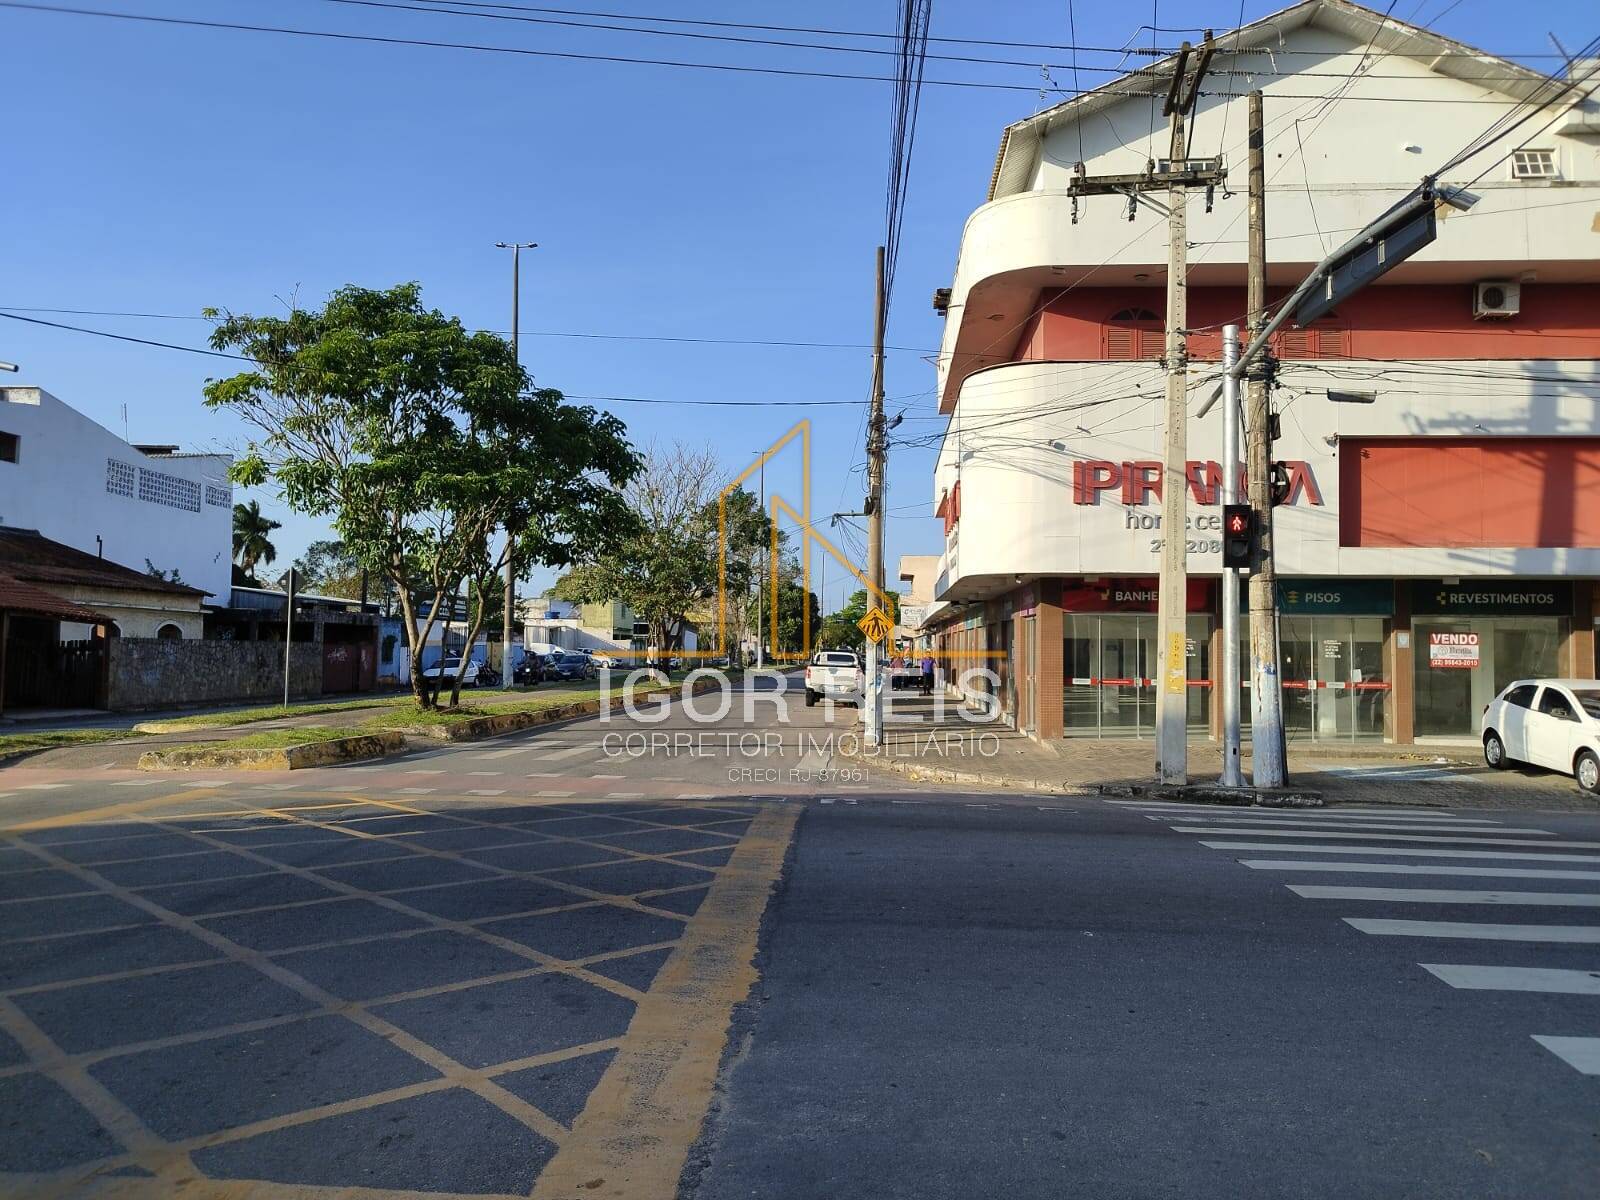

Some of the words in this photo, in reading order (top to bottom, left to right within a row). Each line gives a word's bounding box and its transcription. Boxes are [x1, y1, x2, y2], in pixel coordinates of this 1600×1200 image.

[1073, 460, 1323, 505] IPIRANA
[1115, 591, 1160, 601] BANHE
[1305, 592, 1341, 603] PISOS
[1450, 593, 1554, 604] REVESTIMENTOS
[1432, 633, 1478, 645] VENDO
